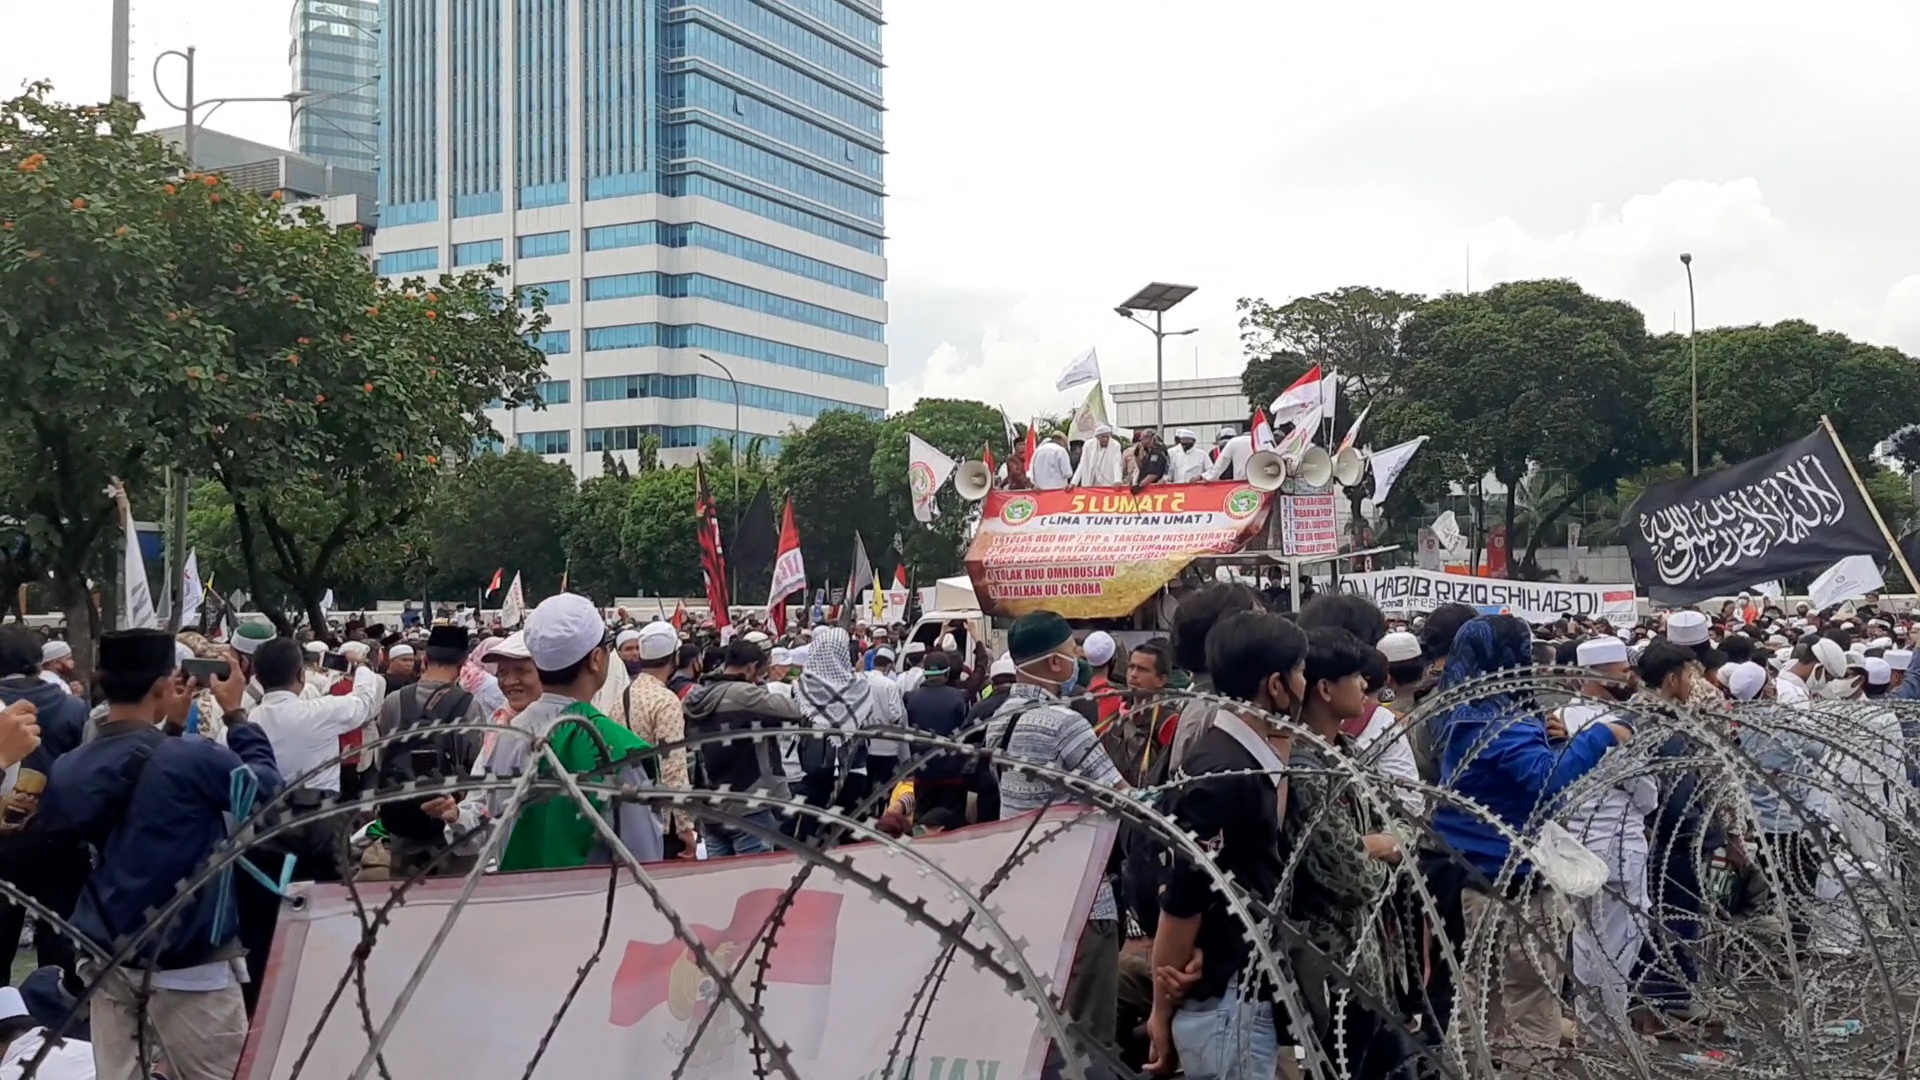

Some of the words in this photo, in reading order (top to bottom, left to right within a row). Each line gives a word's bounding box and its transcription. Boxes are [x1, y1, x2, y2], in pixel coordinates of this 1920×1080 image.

[1069, 495, 1086, 513] 5
[1088, 493, 1168, 513] LUMAT
[1086, 516, 1159, 526] TUNTUTAN
[1005, 535, 1033, 544] TOLAK
[1084, 533, 1101, 542] PIP
[1113, 534, 1160, 542] TANGKAP
[995, 568, 1024, 580] TOLAK
[1025, 568, 1044, 580] RUU
[1047, 565, 1116, 579] OMNIBUSLAW
[1045, 583, 1058, 596] UU
[1061, 582, 1101, 595] CORONA
[1374, 575, 1431, 600] HABIB
[1435, 580, 1488, 605] RIZIQ
